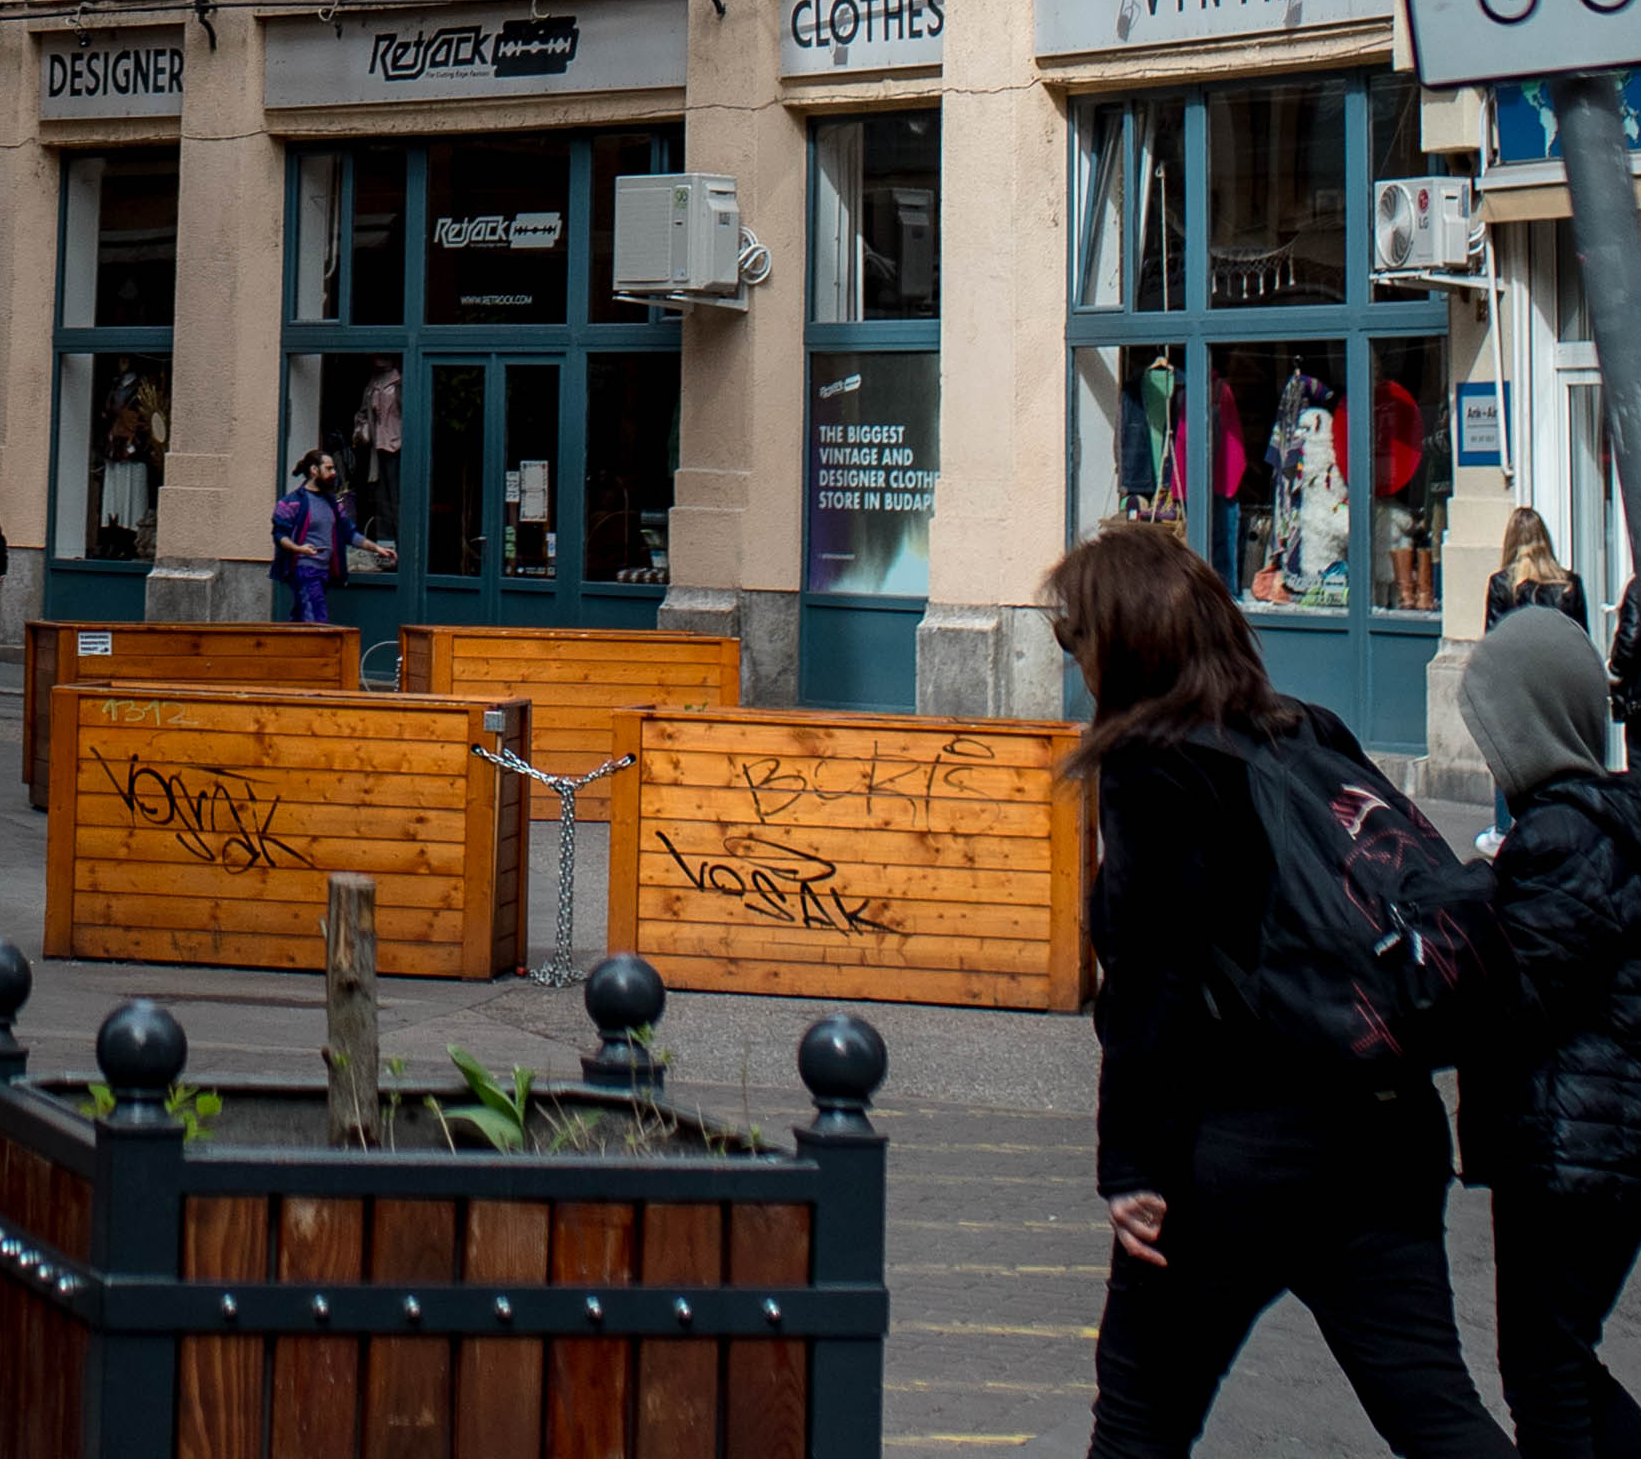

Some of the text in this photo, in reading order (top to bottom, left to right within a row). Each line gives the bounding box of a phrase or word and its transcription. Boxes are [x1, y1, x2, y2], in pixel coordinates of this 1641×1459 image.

[49, 48, 184, 97] DESIGNER
[1418, 216, 1428, 230] LG
[819, 425, 905, 444] THE BIGGEST
[819, 448, 913, 466] VINTAGE AND
[819, 469, 886, 488] DESIGNER
[818, 491, 860, 510] STORE
[864, 492, 880, 510] IN
[102, 699, 199, 725] 1312
